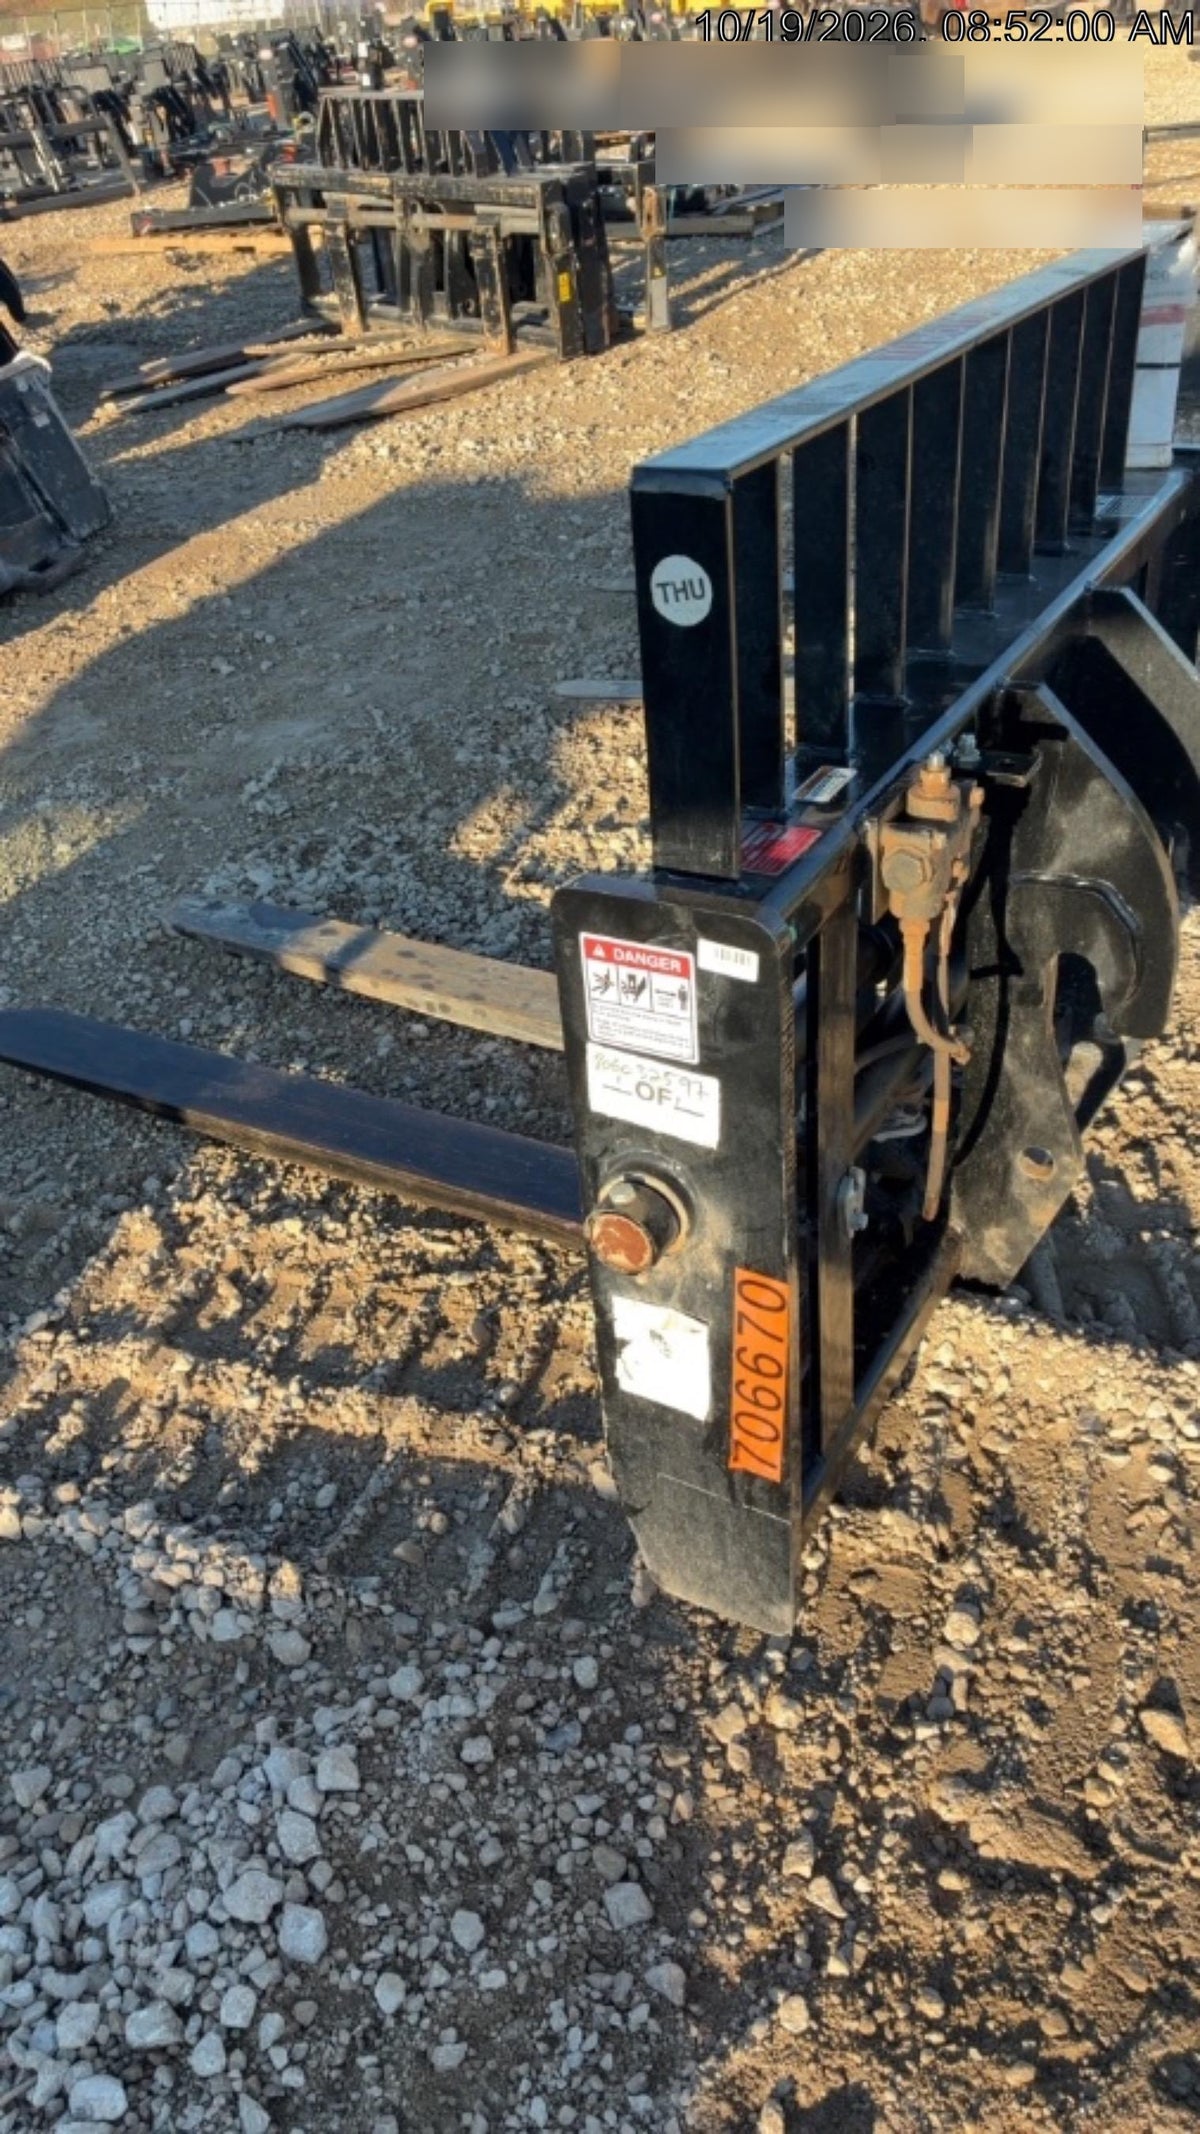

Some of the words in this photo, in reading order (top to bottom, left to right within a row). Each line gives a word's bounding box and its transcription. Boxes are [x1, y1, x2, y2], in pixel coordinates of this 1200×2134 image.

[656, 577, 706, 604] THU
[612, 946, 682, 974] DANGER
[731, 1278, 787, 1470] 706670
